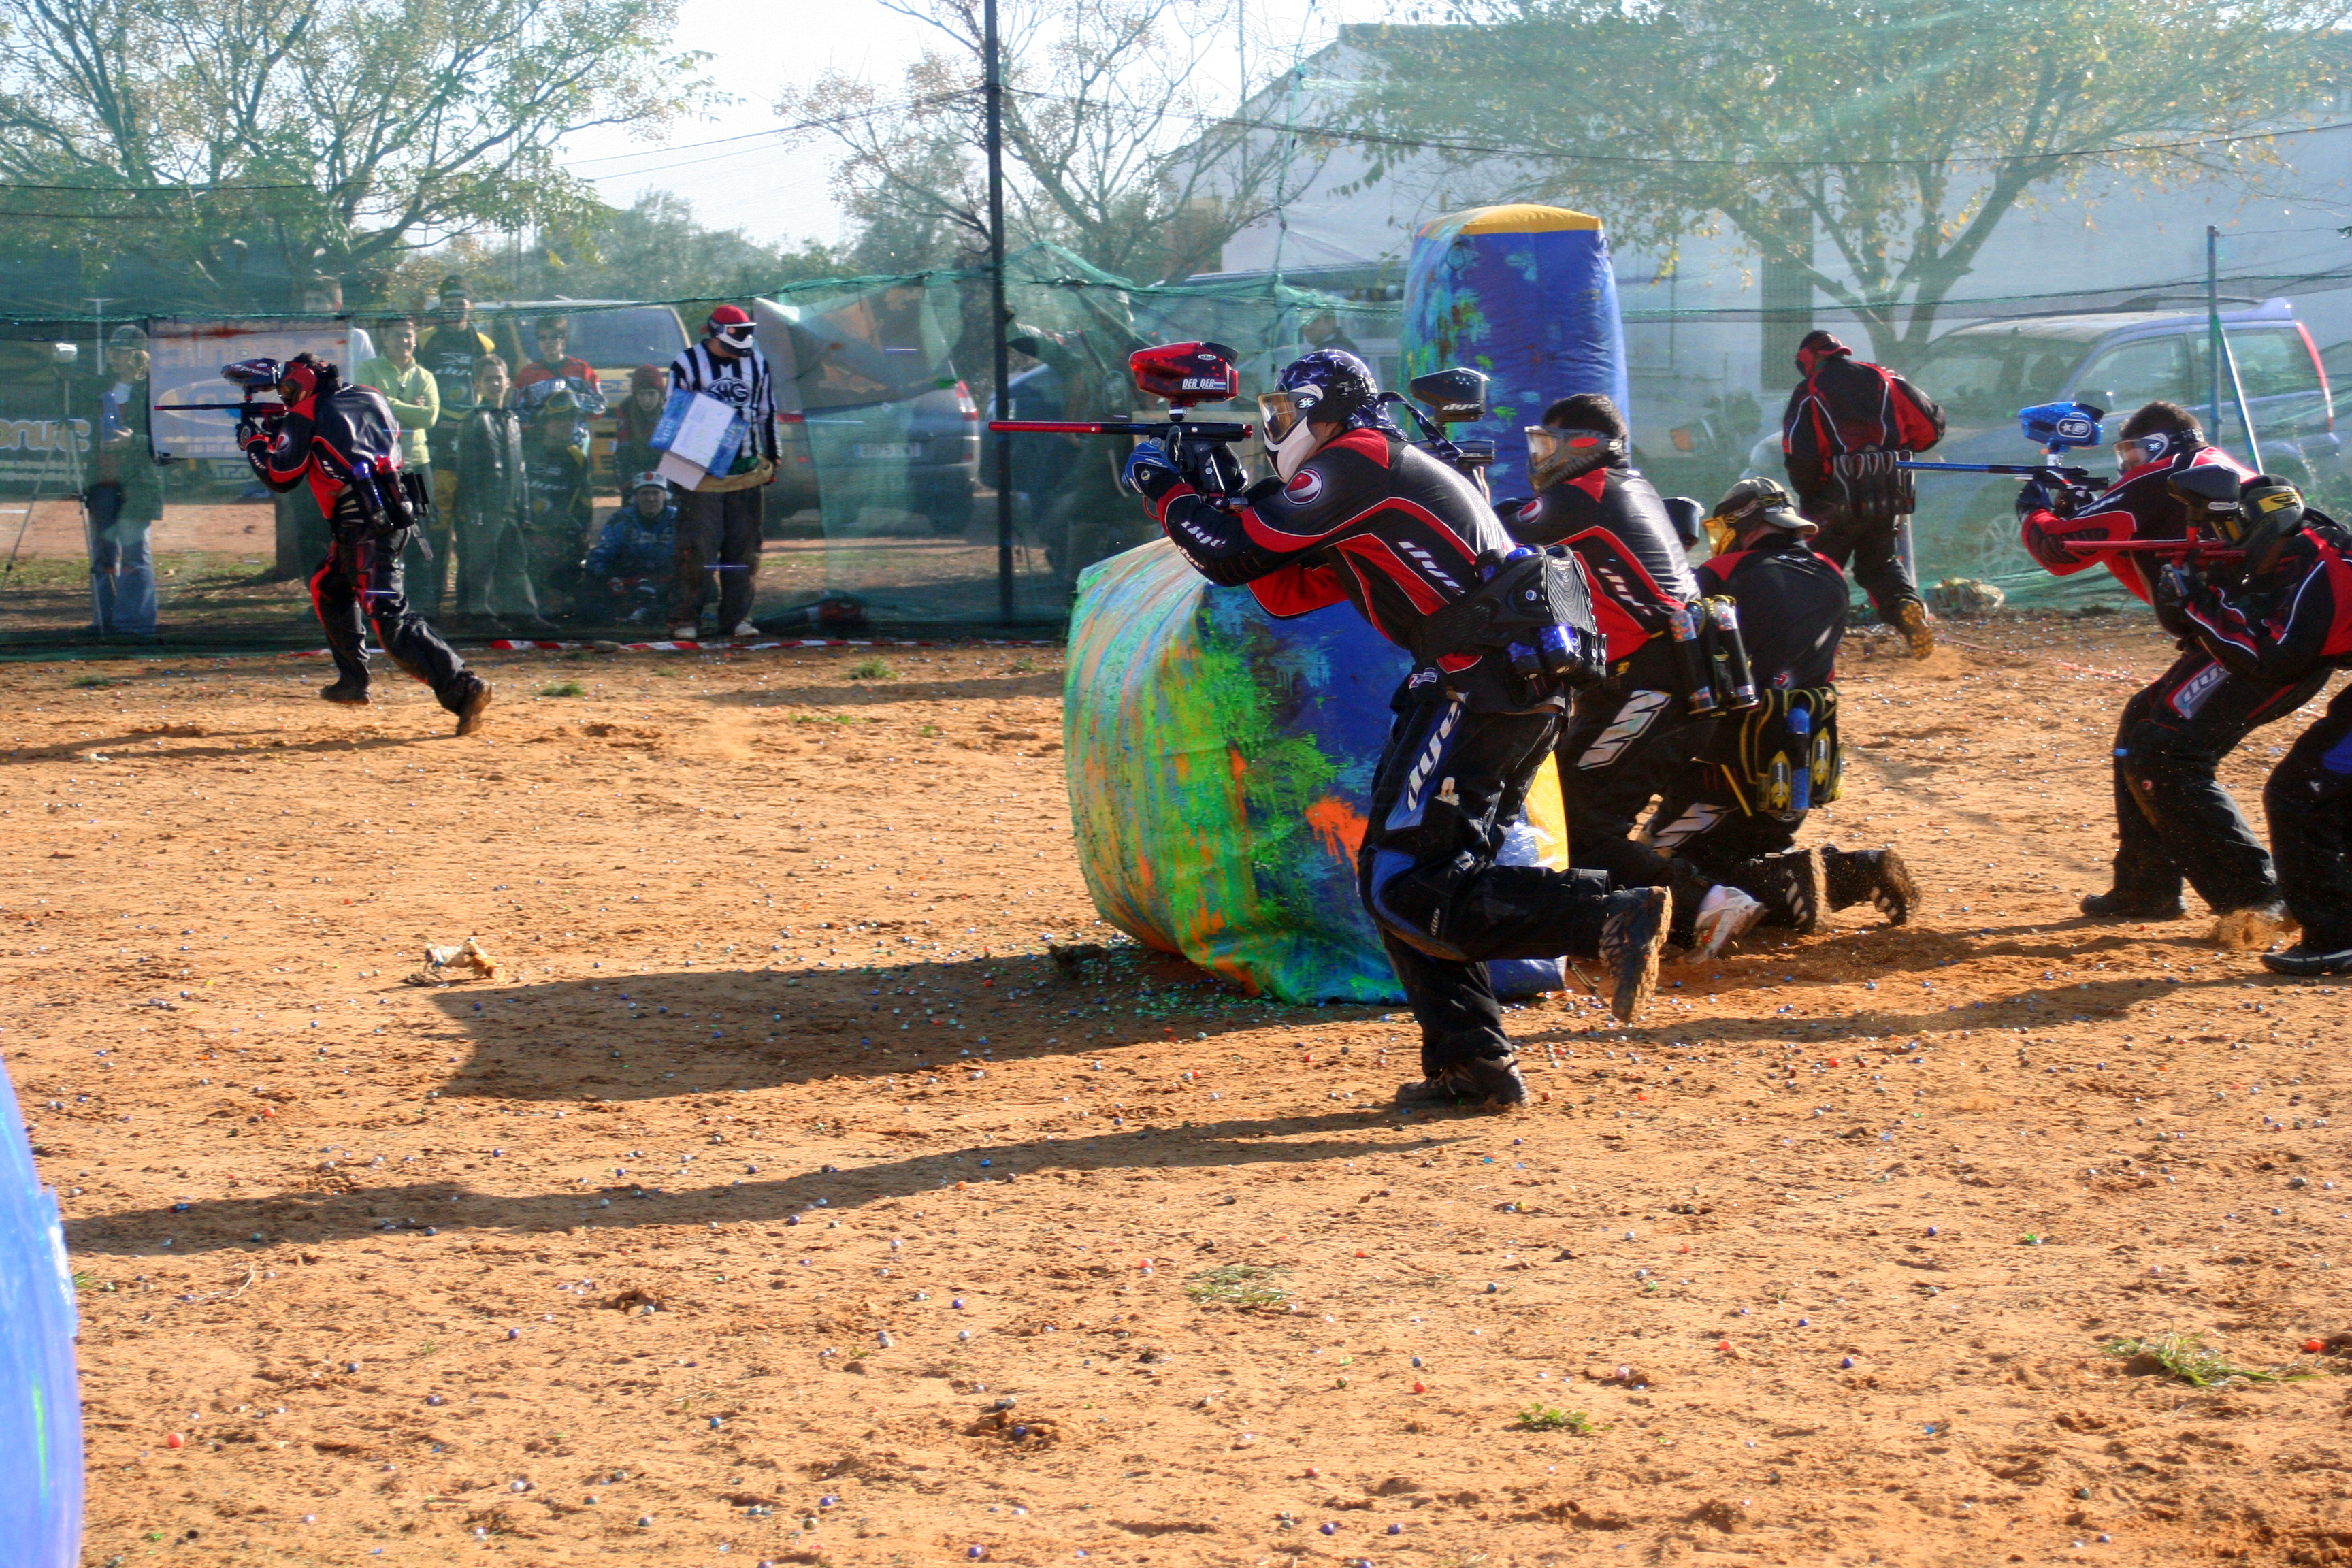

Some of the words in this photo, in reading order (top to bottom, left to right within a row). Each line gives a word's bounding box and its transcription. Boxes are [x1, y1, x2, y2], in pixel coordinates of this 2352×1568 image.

[1182, 378, 1198, 387] DER
[1200, 378, 1215, 387] DER
[1407, 701, 1462, 811] dye
